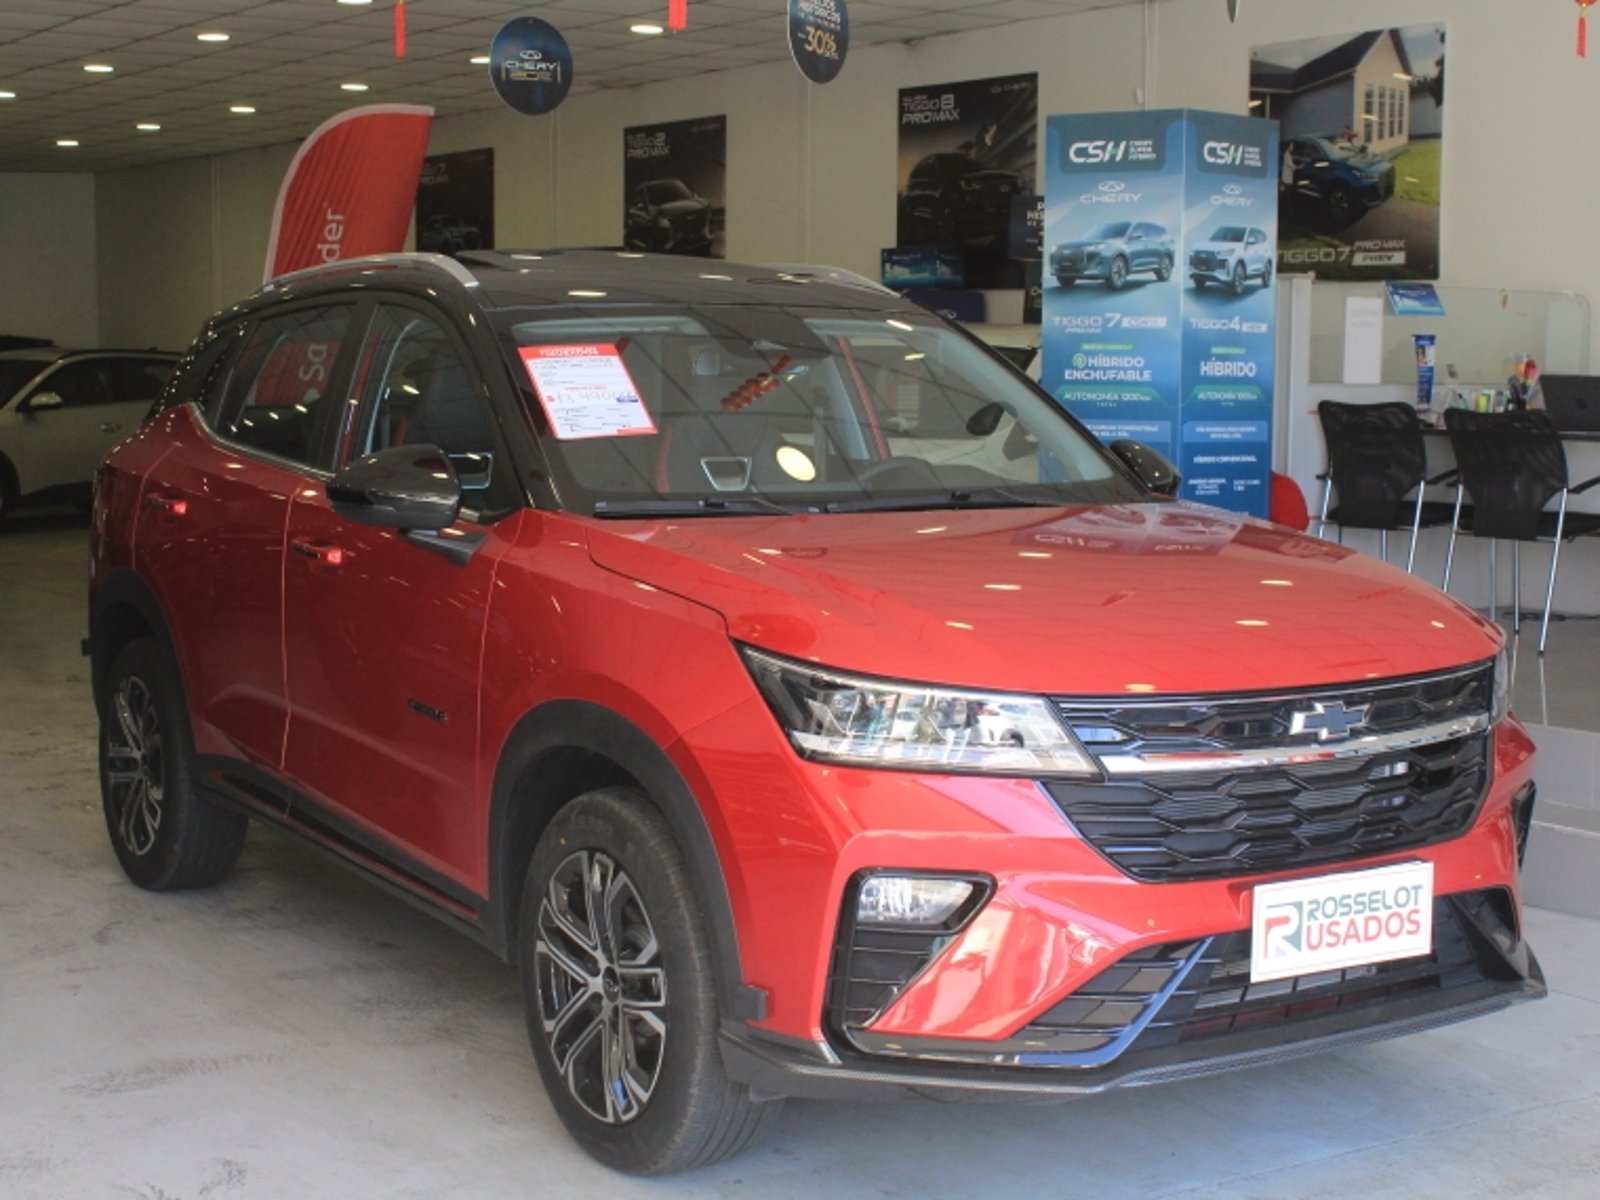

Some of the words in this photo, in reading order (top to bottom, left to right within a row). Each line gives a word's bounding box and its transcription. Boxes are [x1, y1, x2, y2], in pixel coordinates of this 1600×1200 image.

[505, 60, 556, 70] CHERY
[902, 98, 939, 112] TIGGO
[932, 109, 960, 122] MAX
[1069, 140, 1127, 163] CSH
[1203, 141, 1243, 165] CSH
[1080, 193, 1142, 204] CHERY
[1052, 316, 1102, 327] TIGGO
[1104, 313, 1122, 327] 7
[1088, 354, 1144, 367] HÍBRIDO
[1200, 357, 1257, 377] HÍBRIDO
[1064, 369, 1152, 381] ENCHUFABLE
[1307, 884, 1423, 921] ROSSELOT
[1306, 908, 1421, 950] USADOS
